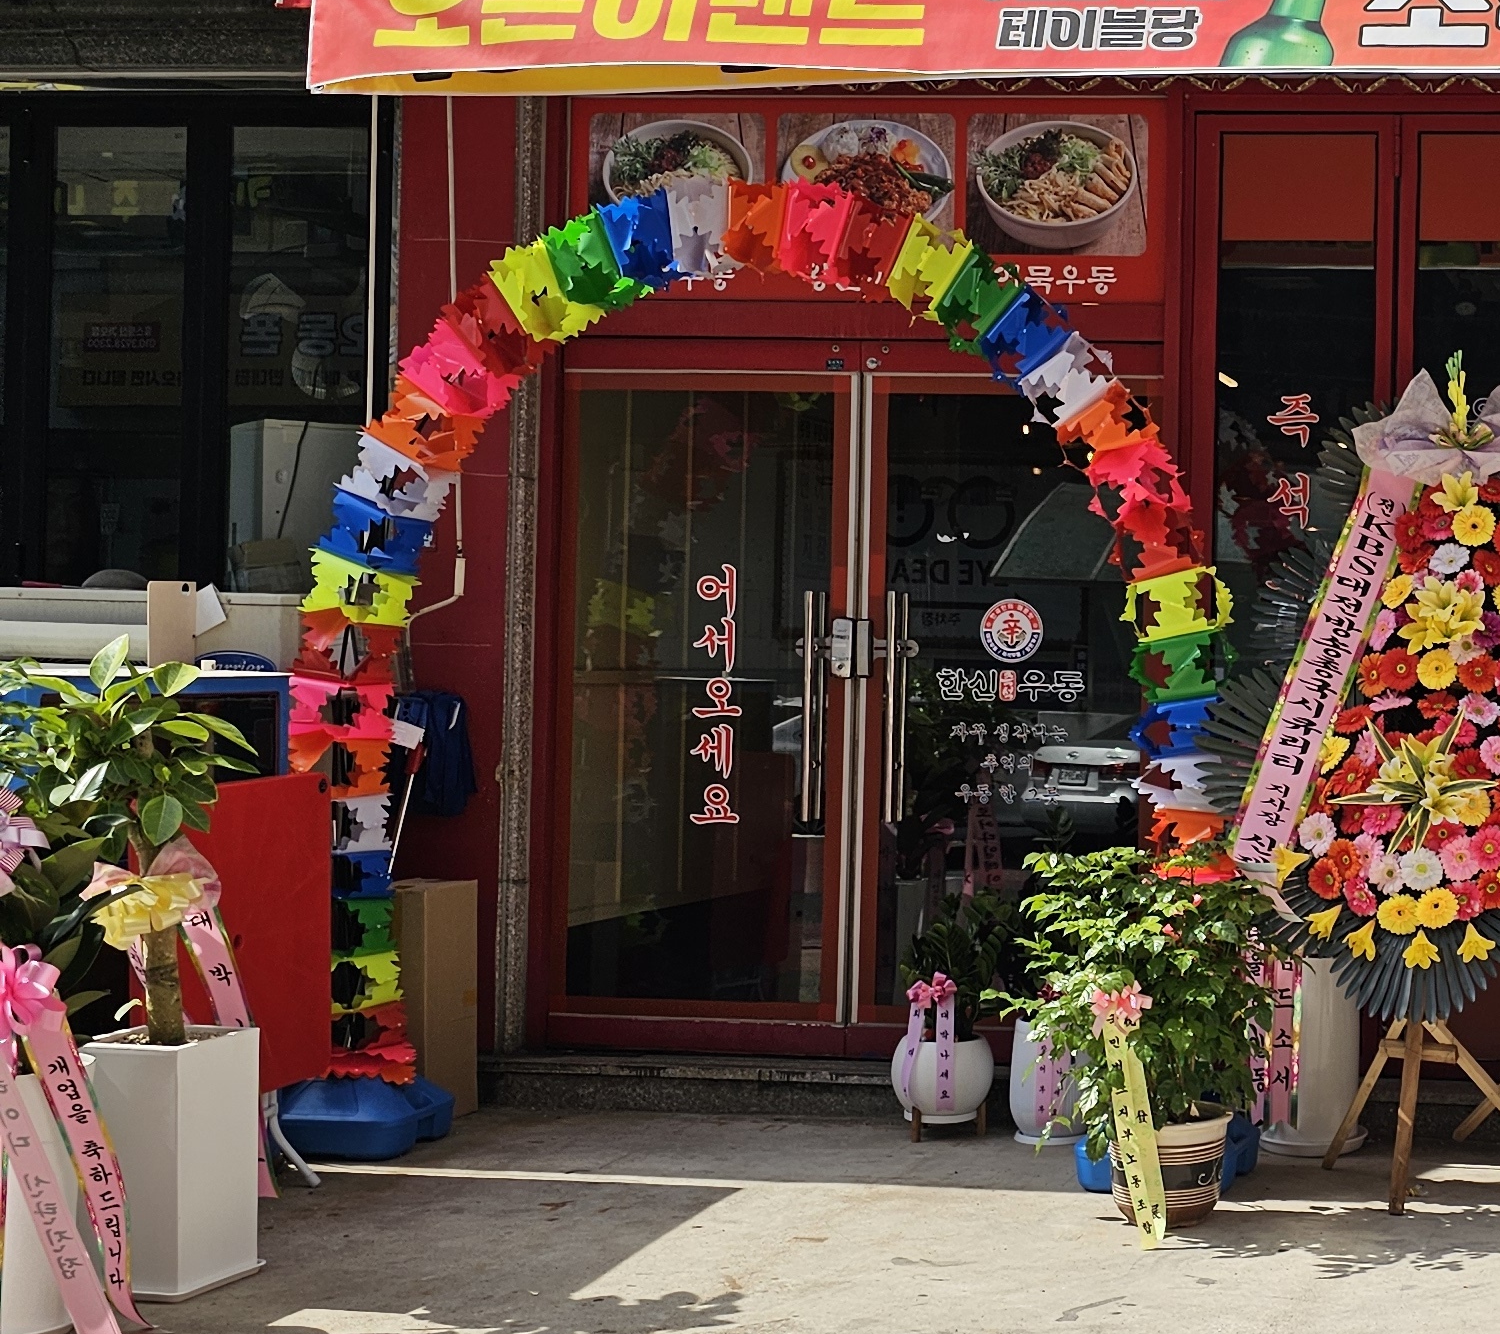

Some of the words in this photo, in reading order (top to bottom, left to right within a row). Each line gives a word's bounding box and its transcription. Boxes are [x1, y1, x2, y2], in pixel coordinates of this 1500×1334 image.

[996, 6, 1202, 52] 테이블당
[1266, 393, 1321, 531] 즉석
[690, 563, 742, 826] 어서오세요
[936, 668, 999, 702] 한신
[1017, 669, 1085, 703] 우동
